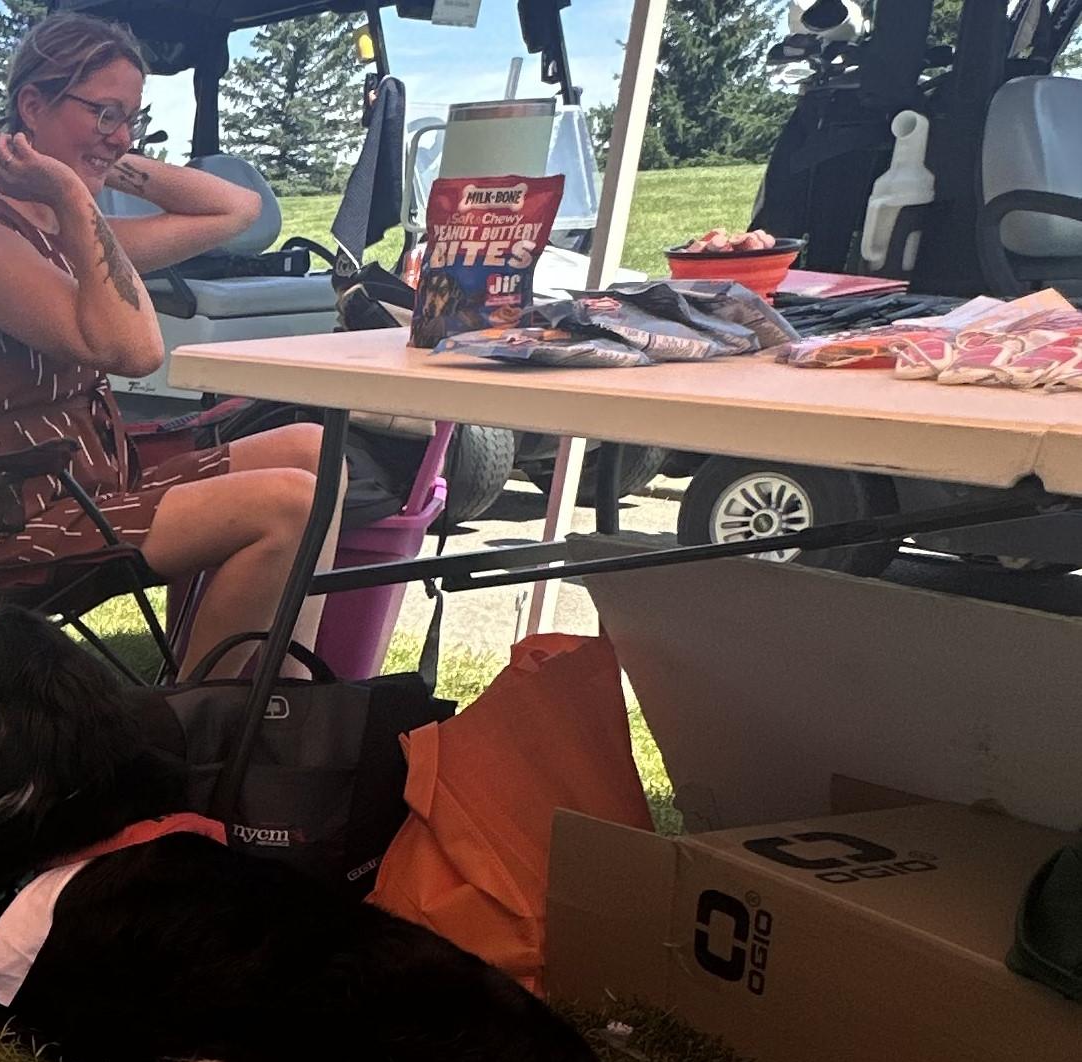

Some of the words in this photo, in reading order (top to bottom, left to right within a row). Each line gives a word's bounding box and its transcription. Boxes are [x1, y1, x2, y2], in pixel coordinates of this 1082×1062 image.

[482, 212, 524, 225] Chewy
[433, 224, 479, 241] PEANUT
[480, 222, 543, 241] BUTTERY
[429, 240, 537, 269] BITES
[488, 273, 521, 295] Jif
[814, 859, 939, 884] OGIO
[747, 909, 772, 995] OGIO
